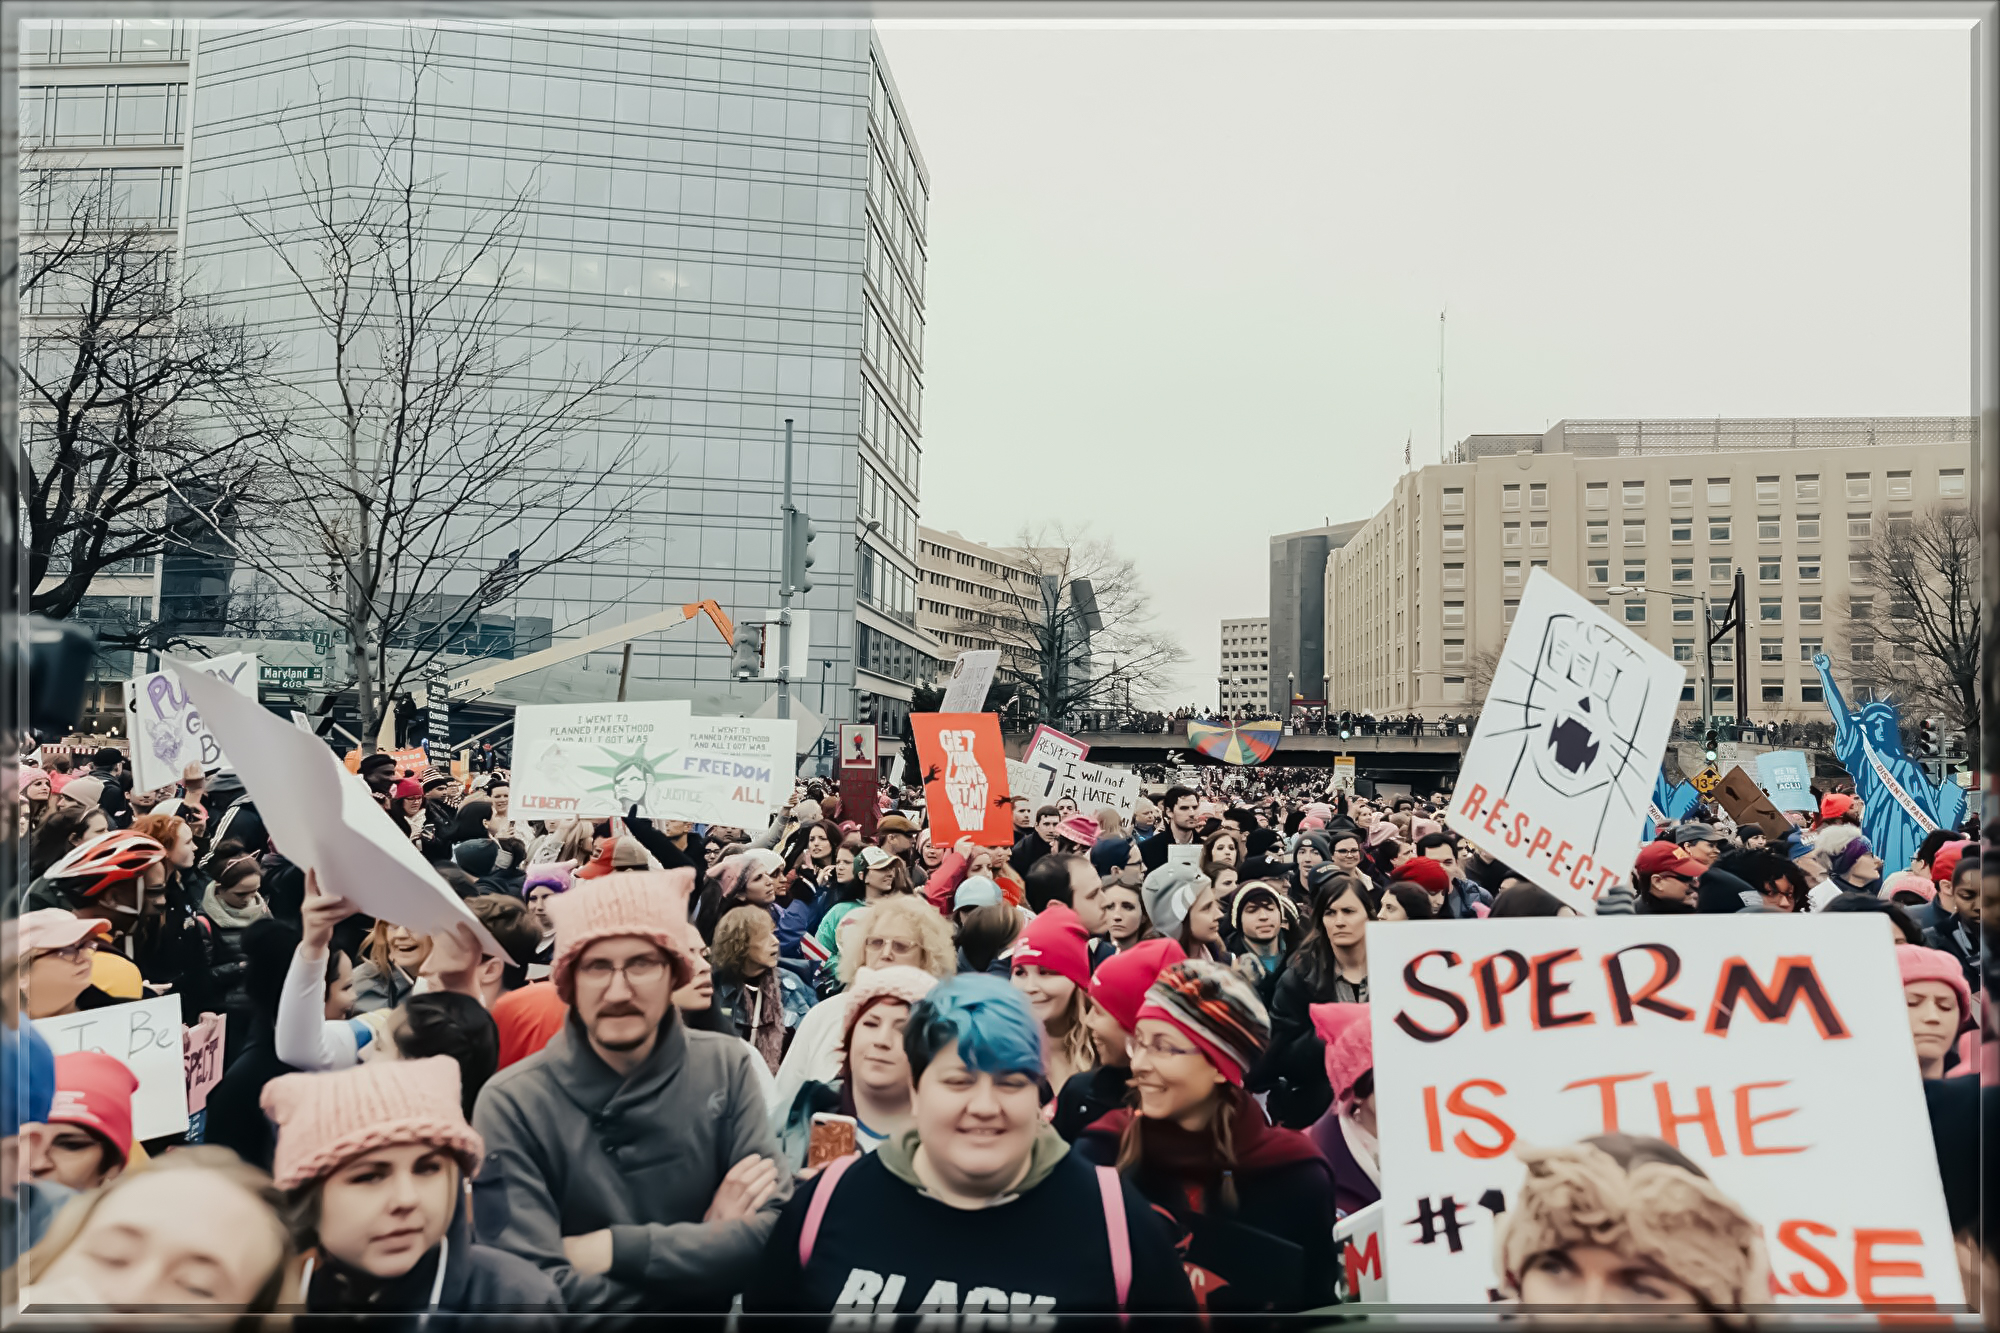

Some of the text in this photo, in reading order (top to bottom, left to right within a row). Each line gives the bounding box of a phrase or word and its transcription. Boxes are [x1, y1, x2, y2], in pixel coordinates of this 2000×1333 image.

[264, 667, 308, 680] Maryland
[586, 715, 613, 724] WENT
[617, 714, 629, 723] TO
[550, 724, 654, 736] PLANNED PARENTHOOD
[627, 734, 648, 743] WAS
[690, 733, 770, 743] PLANNED PARENTHOOD
[718, 726, 739, 734] WENT
[741, 726, 751, 734] TO
[694, 741, 709, 749] AND
[733, 742, 746, 750] GOT
[750, 743, 766, 751] WAS
[939, 729, 976, 752] GET
[1007, 765, 1041, 784] ORCE
[1063, 762, 1125, 788] I will not
[1060, 783, 1078, 798] let
[1083, 785, 1117, 806] HATE
[1779, 782, 1801, 790] ACLU
[1876, 764, 1905, 798] DISSENT
[1902, 799, 1911, 808] IS
[522, 795, 581, 811] LIBERTY
[732, 785, 765, 805] ALL
[1393, 942, 1852, 1043] SPERM
[127, 1010, 174, 1060] Be
[1420, 1071, 1816, 1159] IS THE
